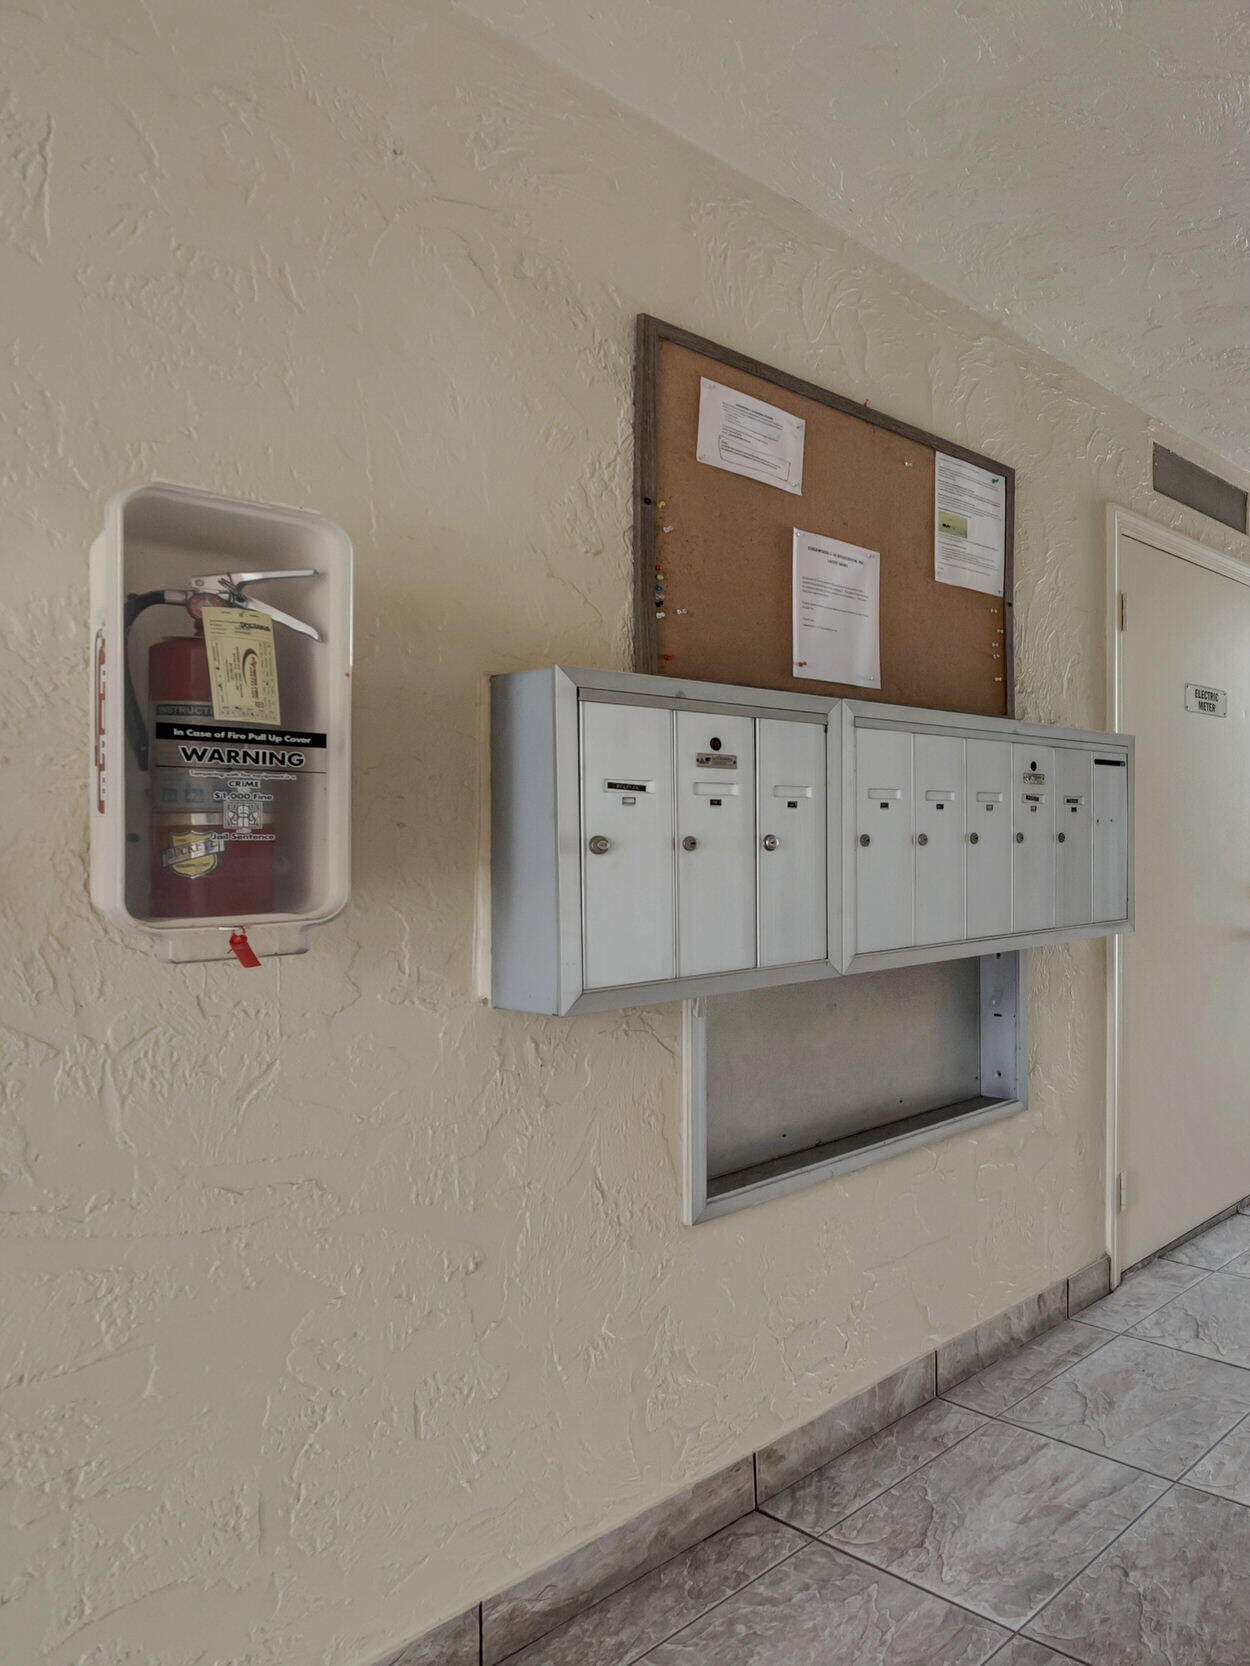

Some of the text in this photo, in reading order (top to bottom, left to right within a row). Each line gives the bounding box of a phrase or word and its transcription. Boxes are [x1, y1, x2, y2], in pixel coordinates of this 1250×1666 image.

[1195, 689, 1219, 702] ELECTRIC
[159, 705, 213, 715] INSTRUCTI
[1198, 700, 1216, 712] METER
[173, 728, 312, 744] In Case of Fire Pull Up Cover
[179, 746, 304, 766] WARNING
